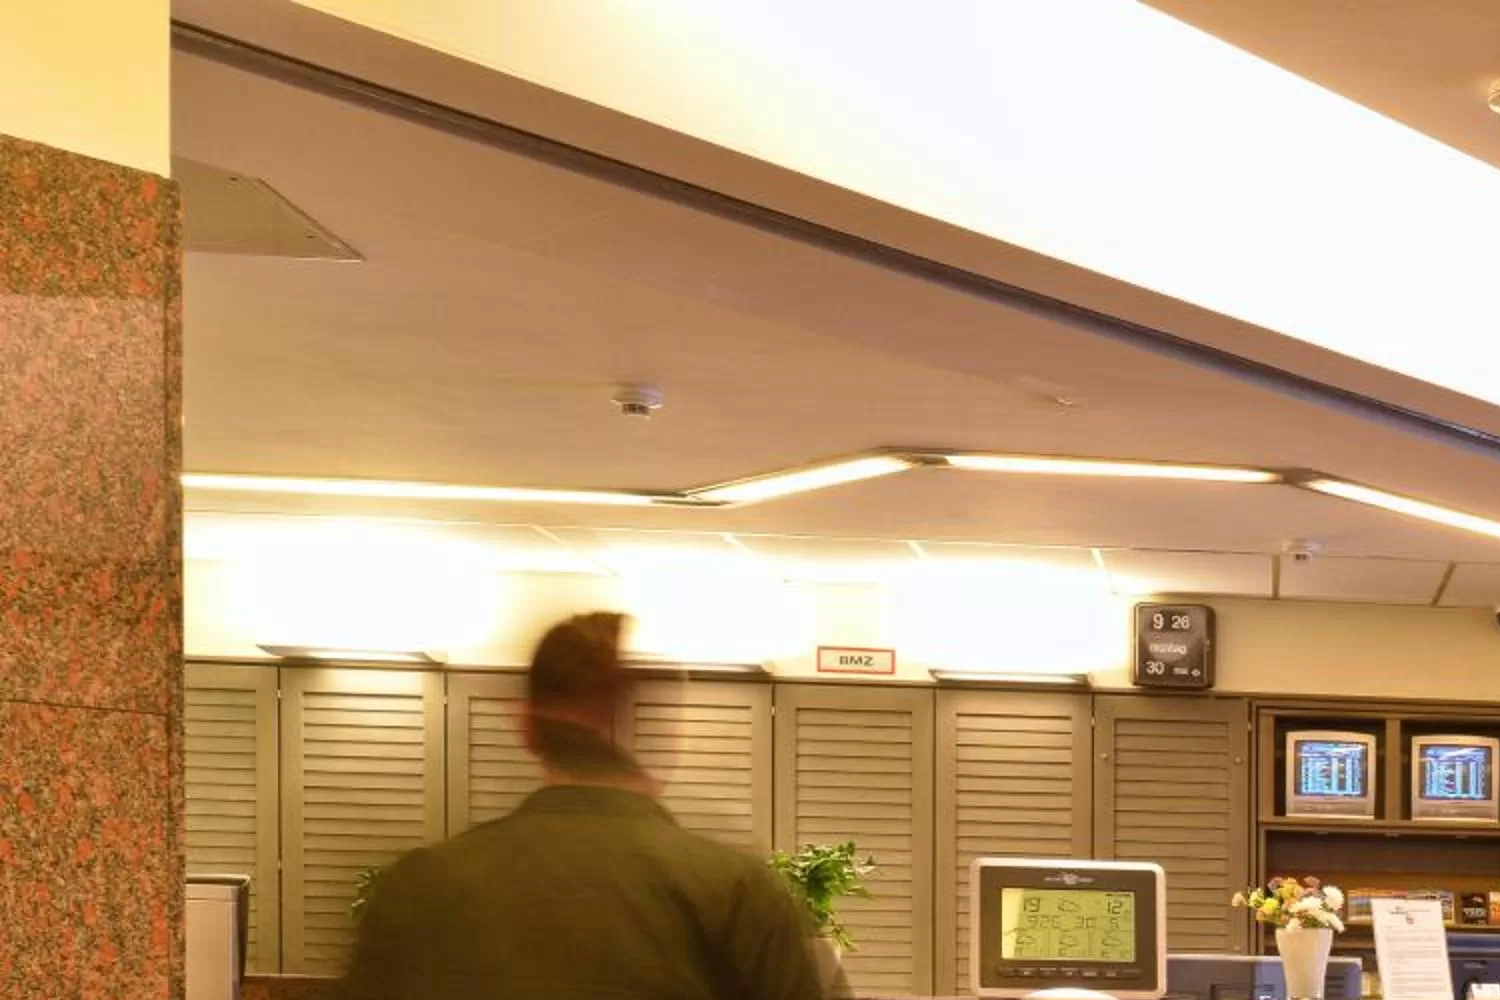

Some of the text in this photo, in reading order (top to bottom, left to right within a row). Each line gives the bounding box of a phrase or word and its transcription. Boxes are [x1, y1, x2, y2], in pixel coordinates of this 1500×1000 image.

[1152, 613, 1191, 630] 9 26
[1145, 660, 1166, 675] 30
